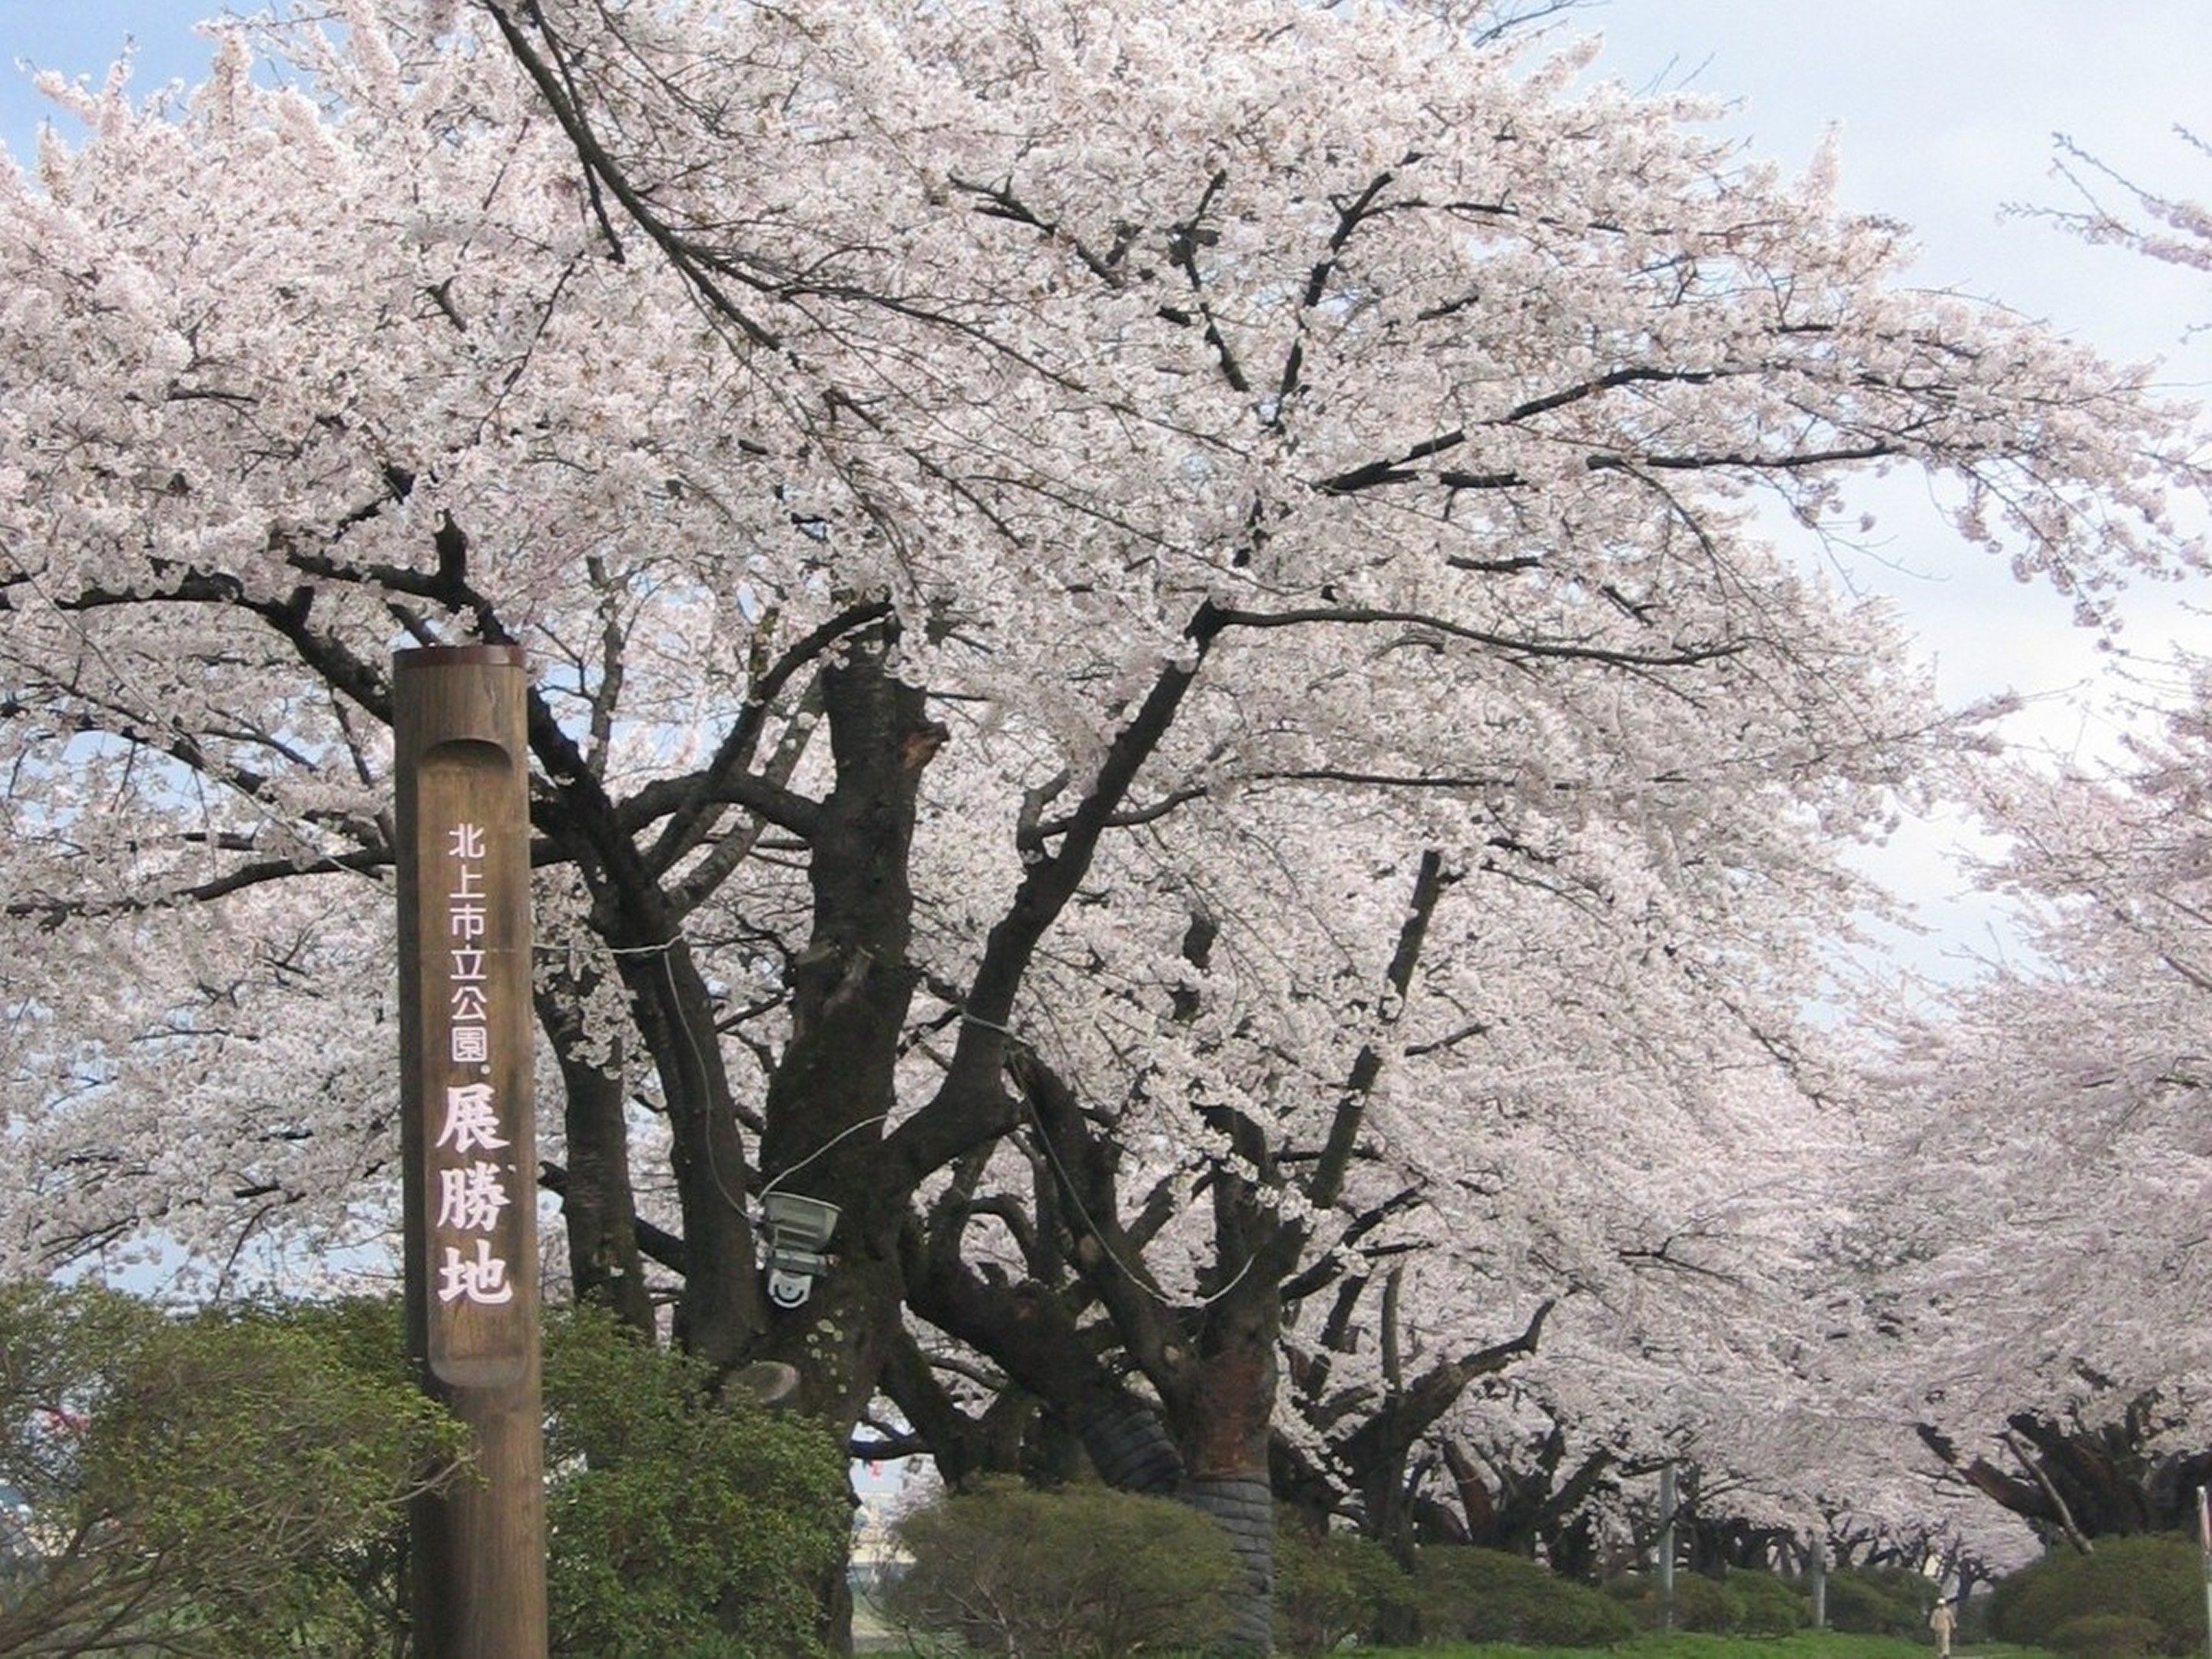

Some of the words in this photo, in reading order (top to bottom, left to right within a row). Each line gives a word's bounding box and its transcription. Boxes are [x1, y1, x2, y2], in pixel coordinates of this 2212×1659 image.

[449, 823, 487, 1062] 北上市立公園
[435, 1083, 513, 1305] 展勝地
